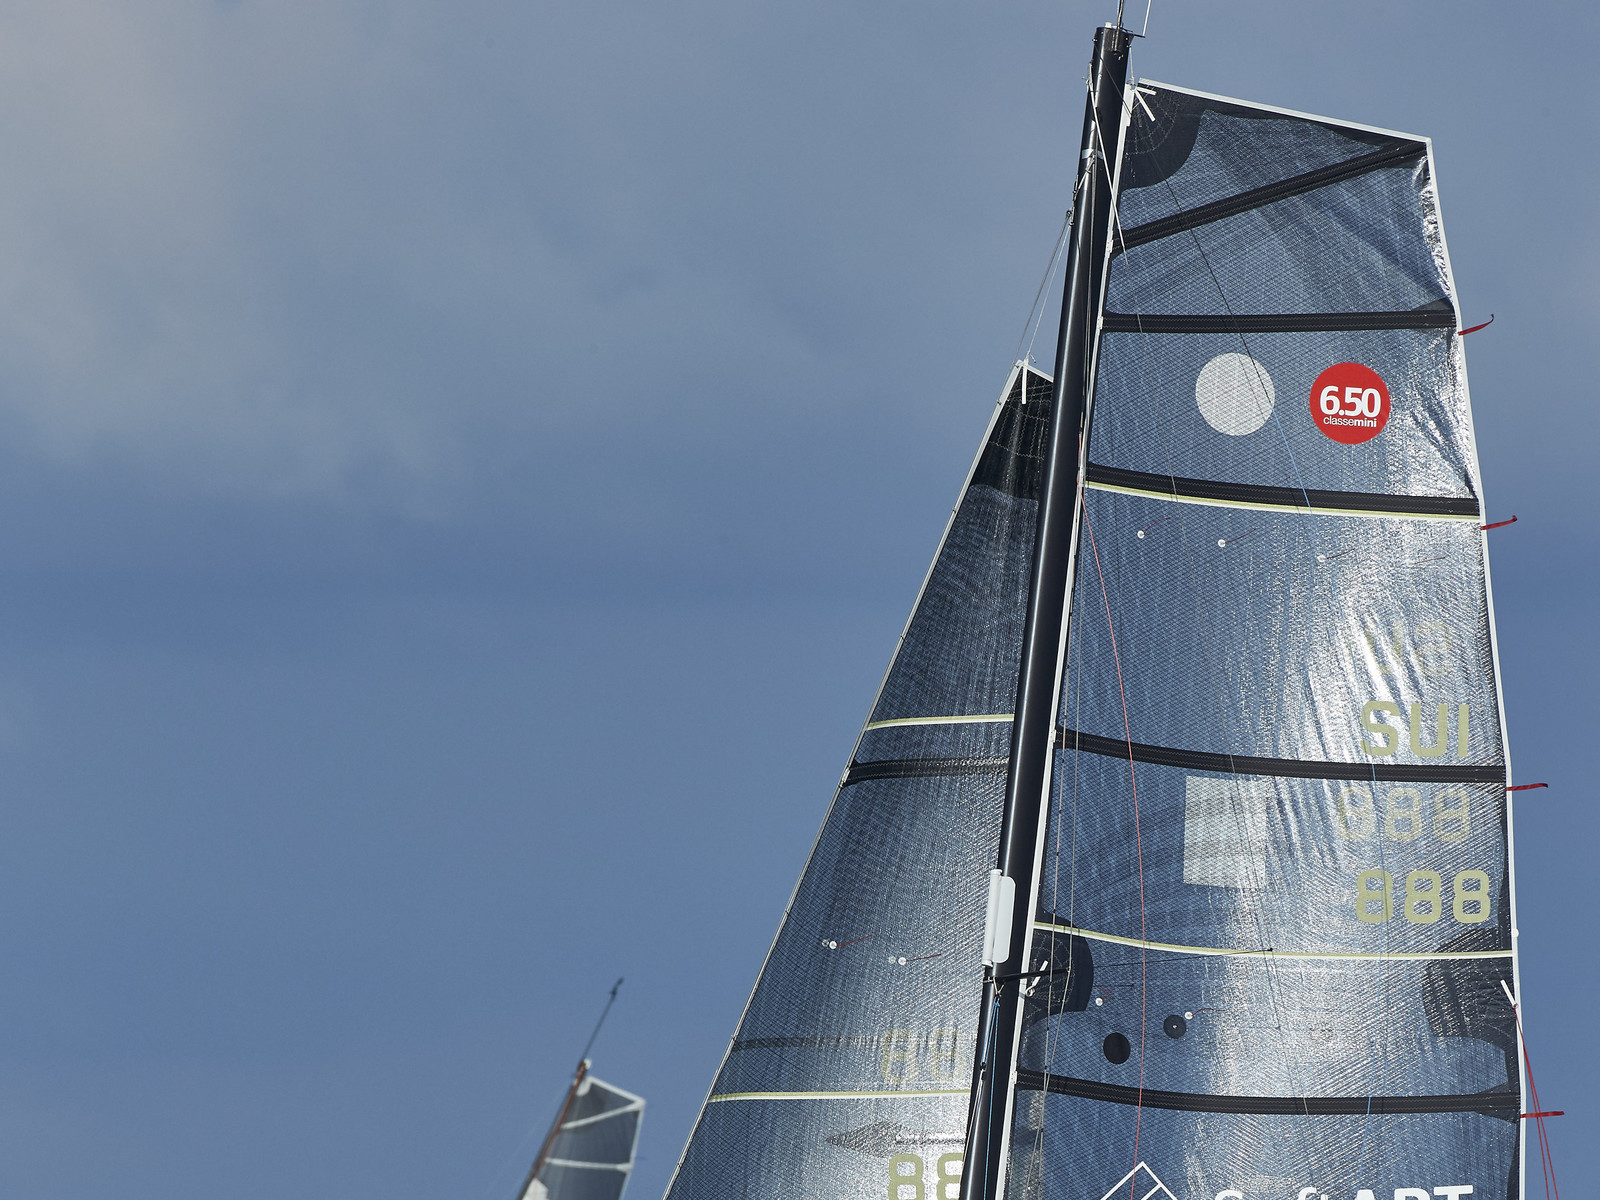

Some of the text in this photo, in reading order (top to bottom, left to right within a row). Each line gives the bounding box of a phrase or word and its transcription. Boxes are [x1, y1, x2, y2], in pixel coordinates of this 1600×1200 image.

[1320, 386, 1381, 417] 6.50
[1323, 416, 1377, 427] classemini
[1360, 700, 1470, 758] SUI
[1356, 869, 1491, 924] 888
